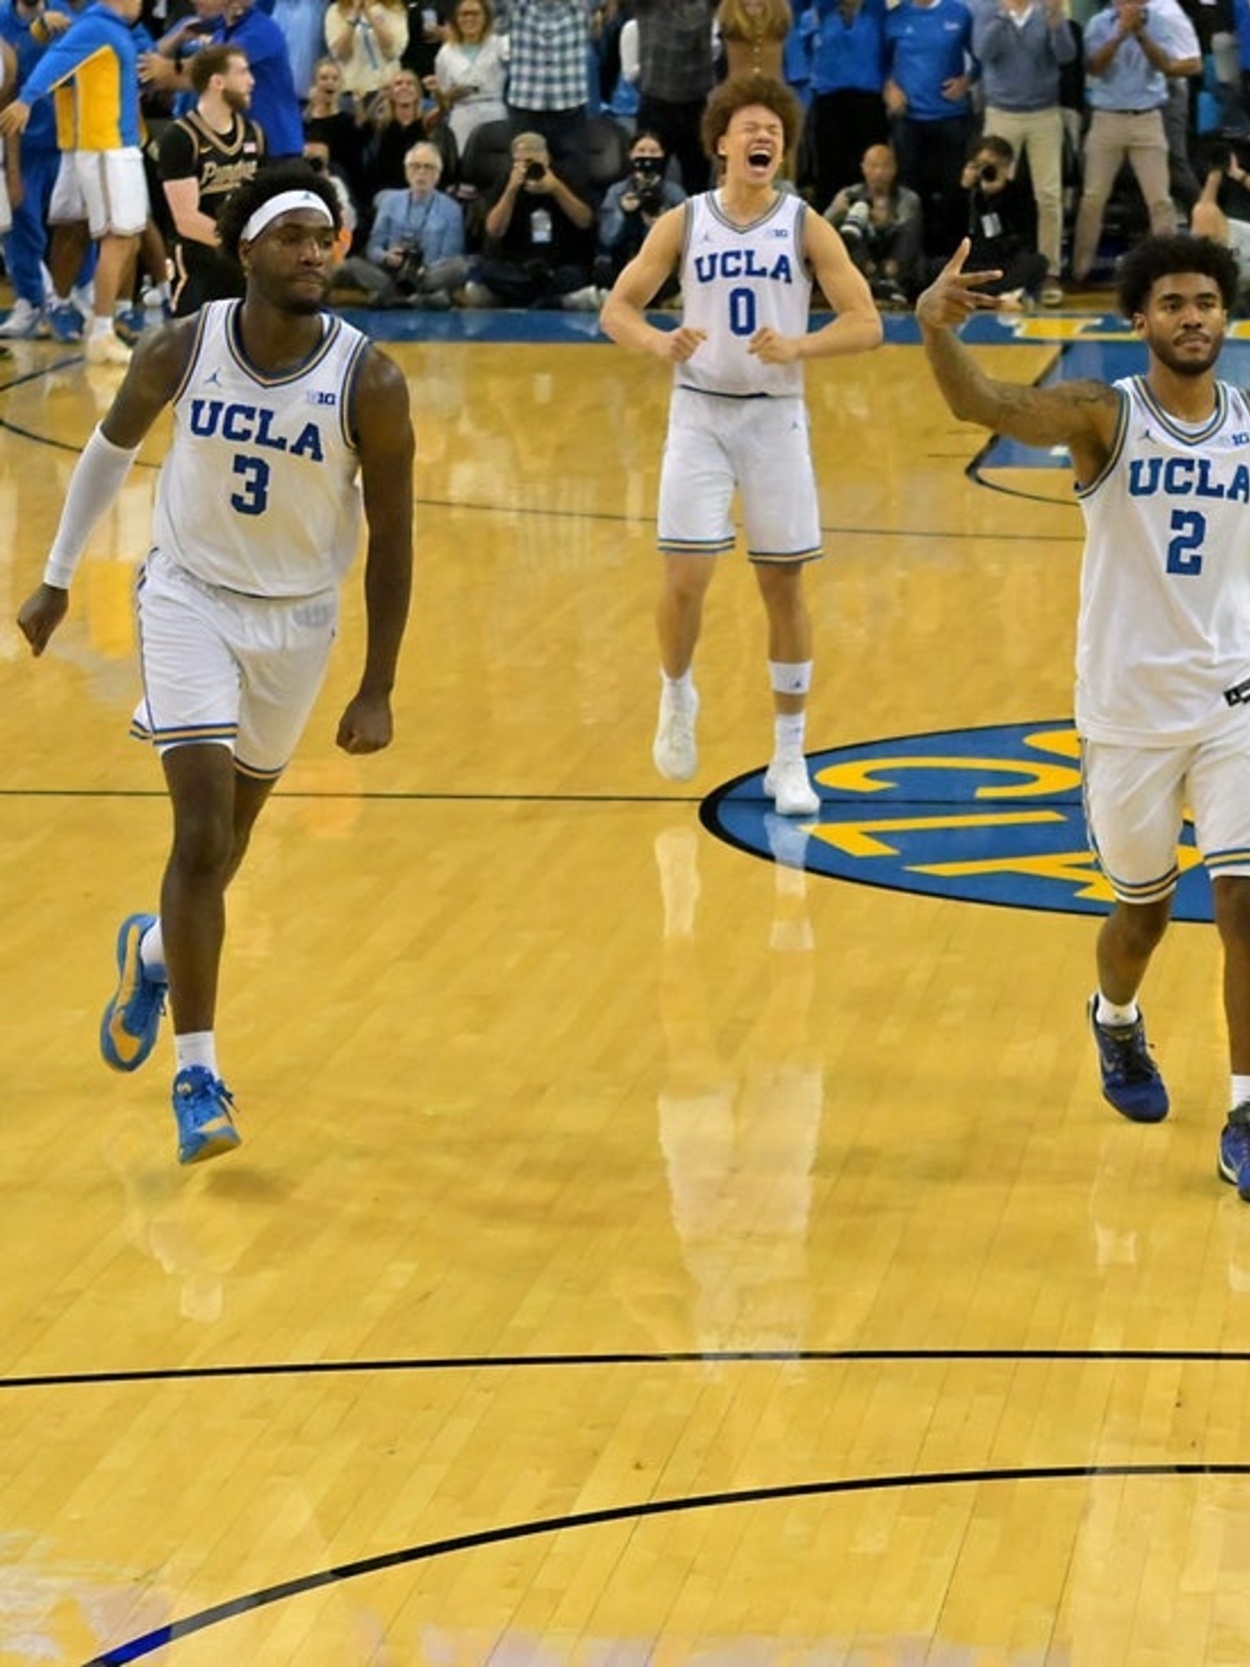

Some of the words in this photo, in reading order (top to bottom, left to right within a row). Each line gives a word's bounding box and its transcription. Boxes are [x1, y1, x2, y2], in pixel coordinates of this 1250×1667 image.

[694, 249, 792, 285] UCLA
[729, 287, 756, 336] 0
[190, 399, 324, 463] UCLA
[231, 454, 270, 516] 3
[1128, 457, 1250, 504] UCLA
[1166, 509, 1206, 576] 2
